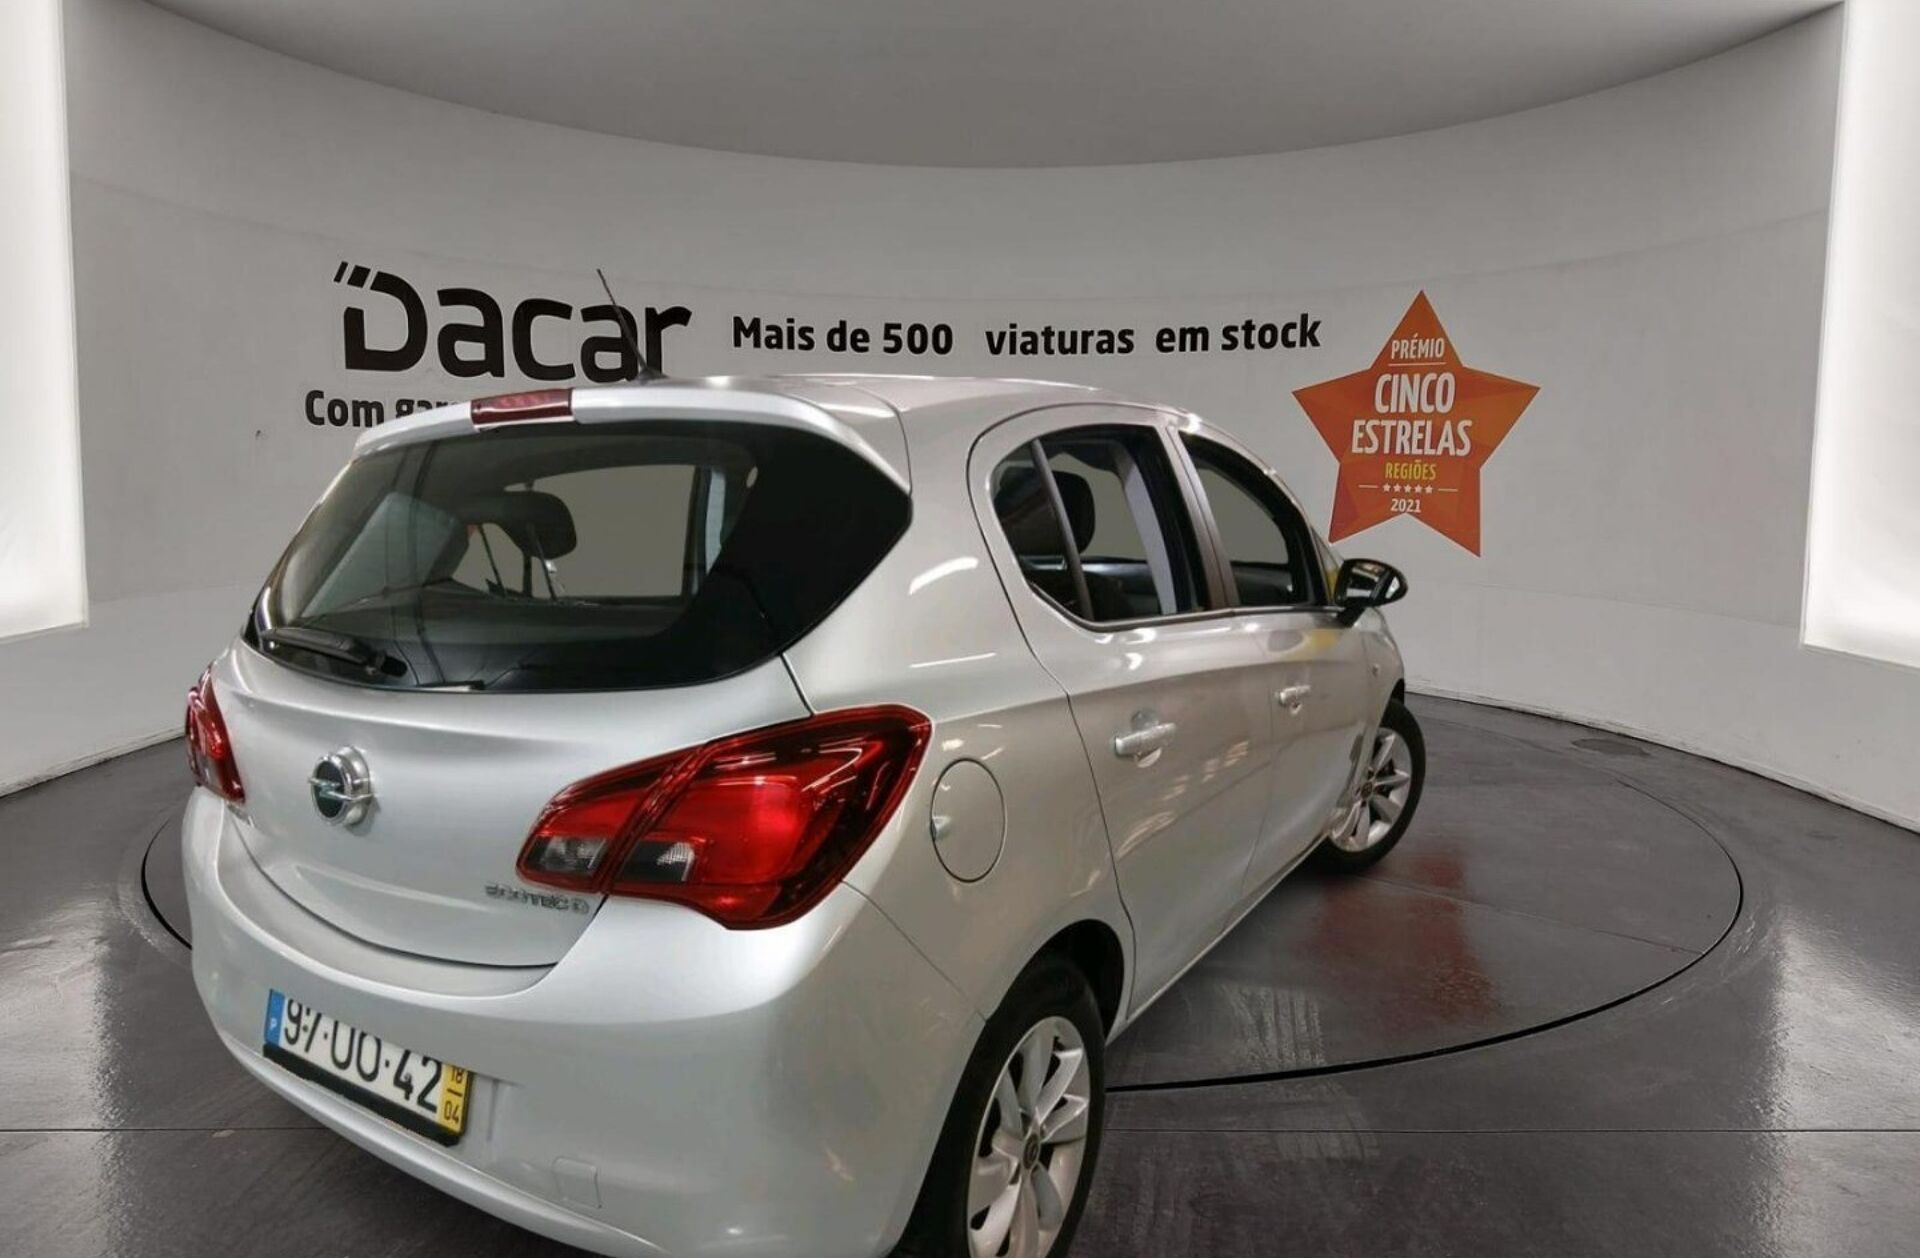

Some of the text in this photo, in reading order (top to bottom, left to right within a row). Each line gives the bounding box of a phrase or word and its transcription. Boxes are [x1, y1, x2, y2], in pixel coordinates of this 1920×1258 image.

[333, 261, 692, 384] Dacar
[732, 313, 1321, 355] Mais de 500 viaturas em stock
[1391, 333, 1445, 360] PRÉMIO
[305, 390, 385, 428] Com
[1374, 372, 1456, 414] CINCO
[1351, 419, 1473, 457] ESTRELAS
[1385, 460, 1437, 480] REGIÕES
[1390, 498, 1421, 513] 2021
[443, 1100, 460, 1125] 04
